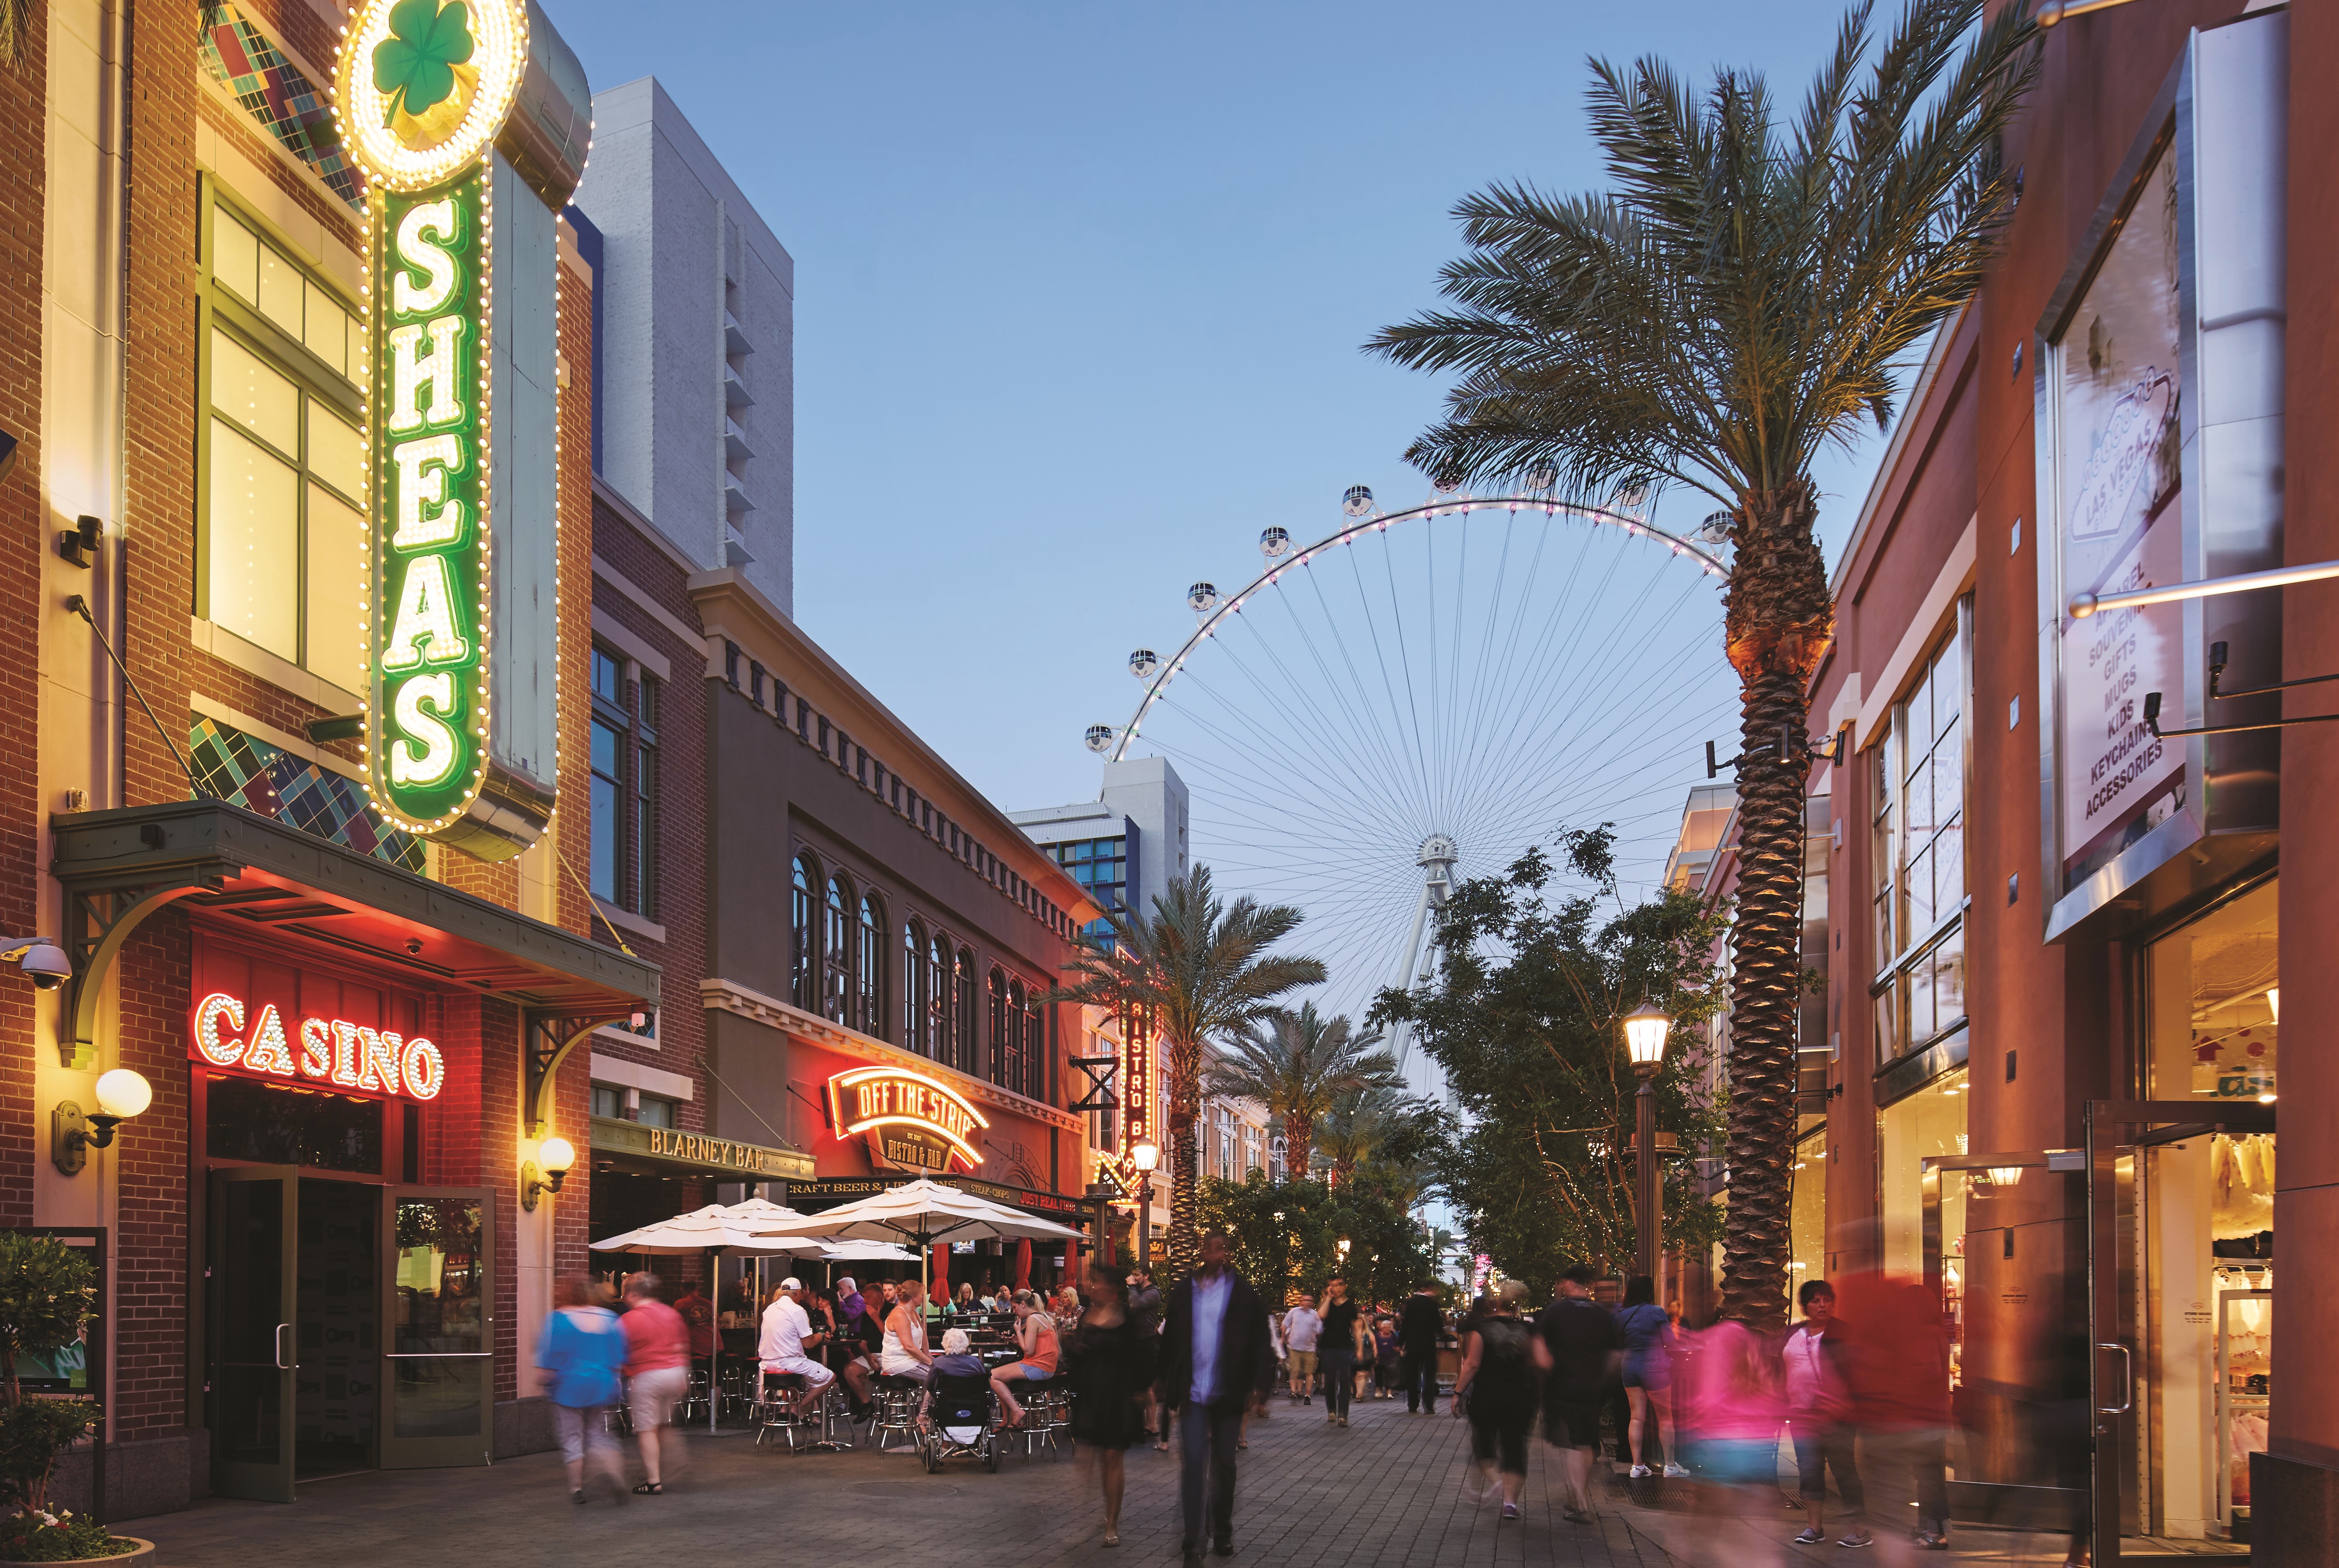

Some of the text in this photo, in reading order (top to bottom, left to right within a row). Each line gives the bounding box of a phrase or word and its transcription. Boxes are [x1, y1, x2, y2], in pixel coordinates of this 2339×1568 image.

[2086, 418, 2151, 527] LAS VEGAS
[2104, 632, 2136, 681] GIFTS
[2104, 664, 2137, 713] MUGS
[2107, 699, 2134, 739] KIDS
[2085, 738, 2163, 821] ACCESSORIES
[194, 992, 445, 1101] CASINO
[857, 1080, 973, 1142] OFF THE STRIP
[651, 1129, 765, 1171] BLARNEY BAR
[888, 1139, 941, 1169] BISTRO & BAR
[833, 1182, 870, 1192] BEER
[872, 1182, 882, 1191] &
[1019, 1191, 1039, 1207] JUST
[1040, 1195, 1059, 1210] REAL
